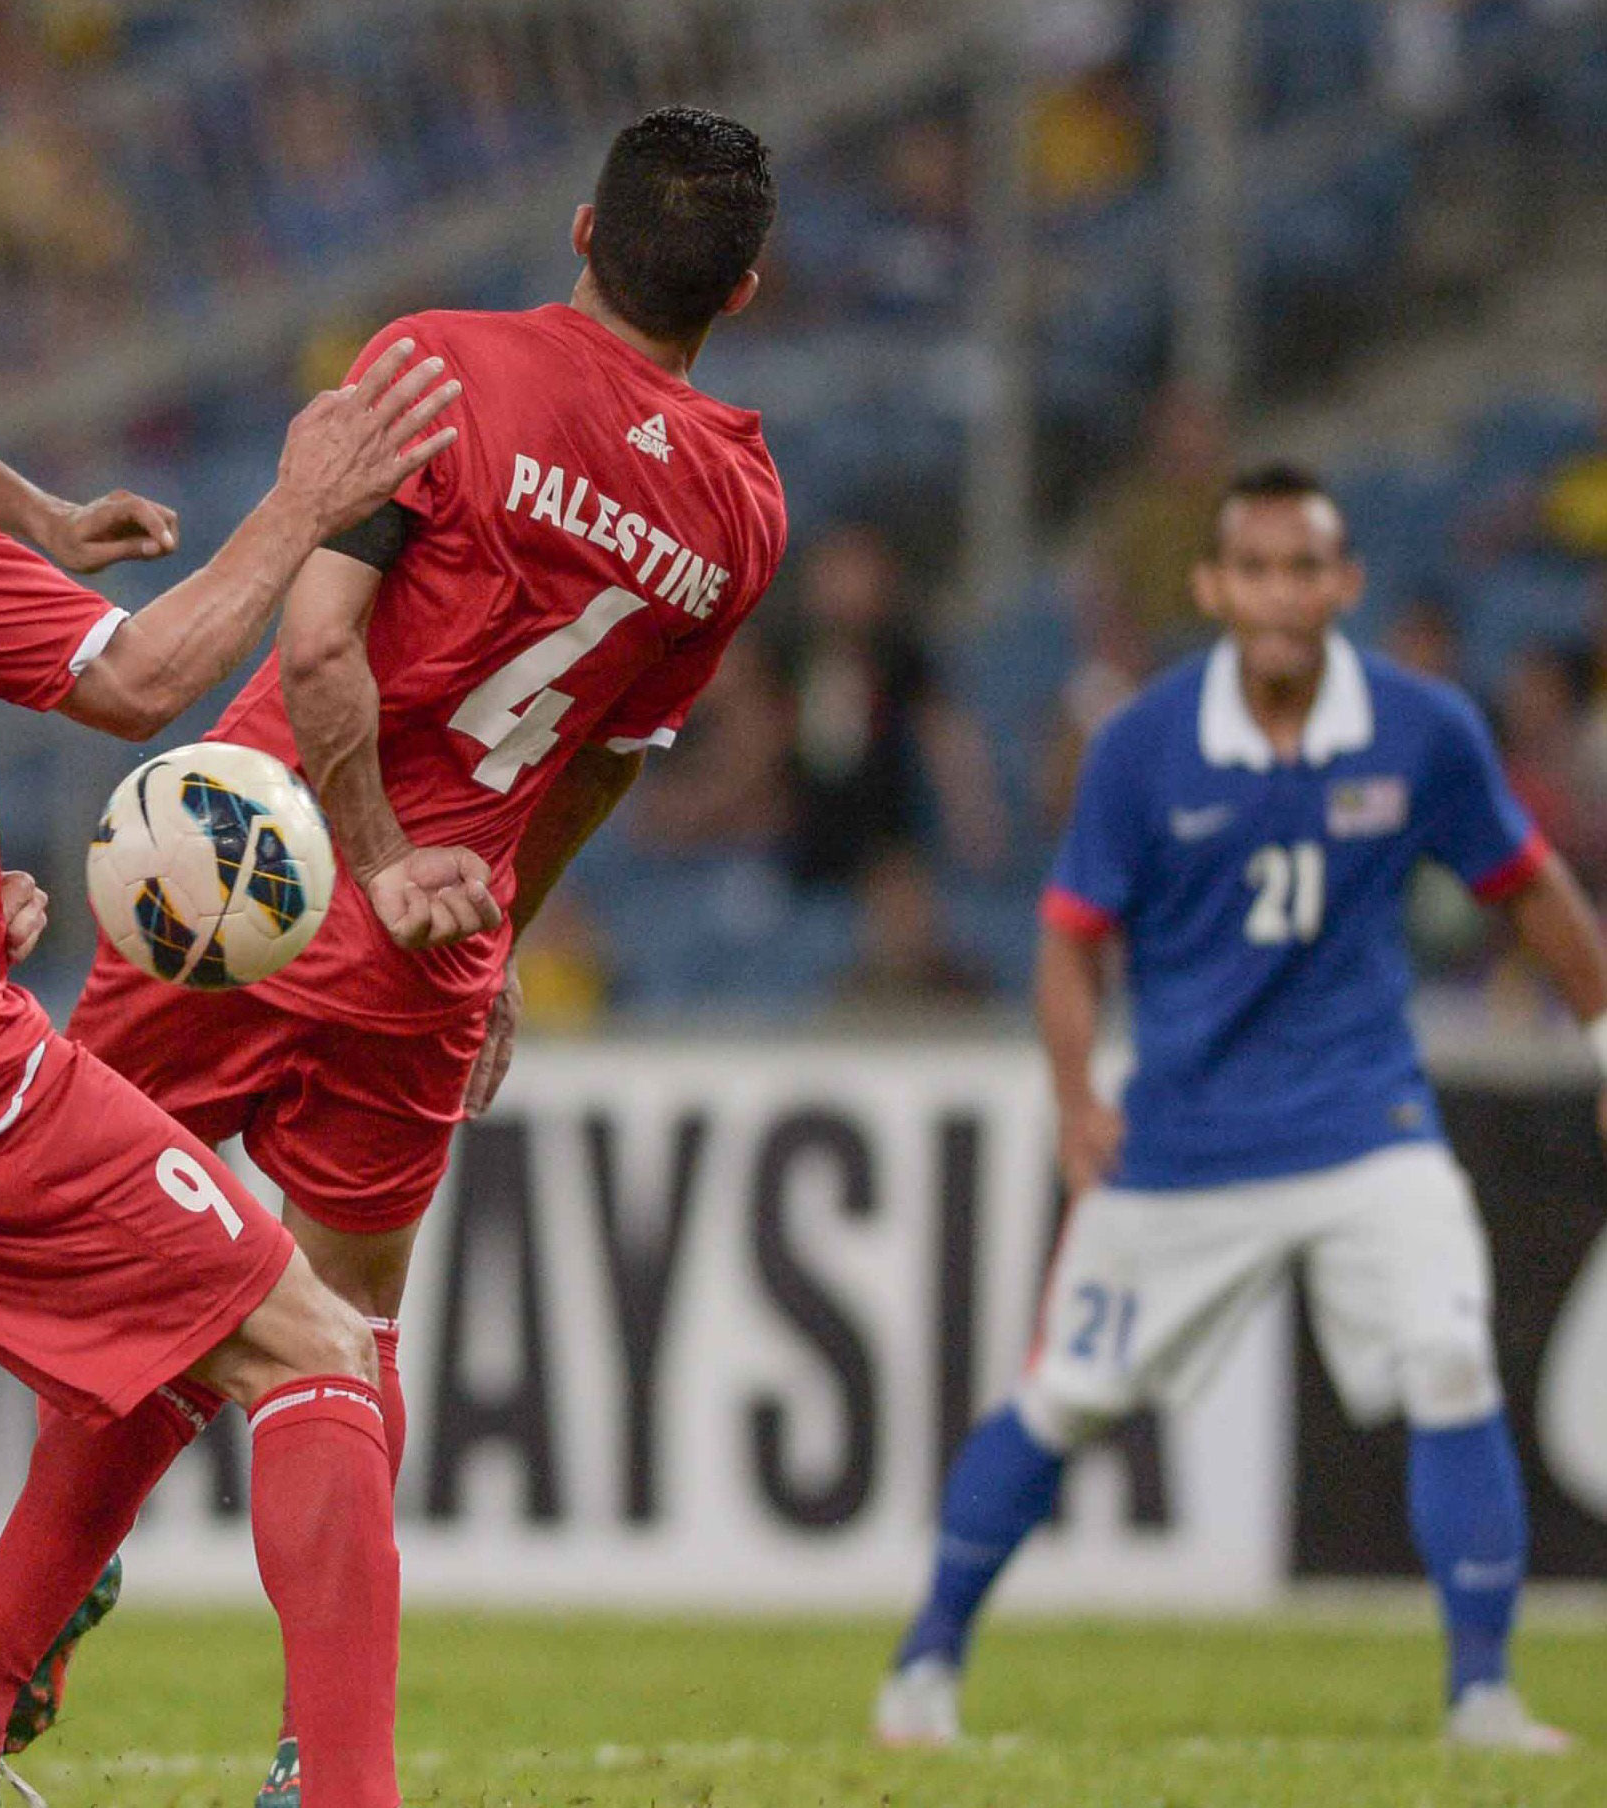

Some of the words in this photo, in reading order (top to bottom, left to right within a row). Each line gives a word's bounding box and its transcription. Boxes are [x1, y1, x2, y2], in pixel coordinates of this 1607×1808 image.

[626, 426, 674, 464] PEAK
[505, 453, 731, 620] PALESTINE
[448, 585, 650, 794] 4
[1244, 843, 1326, 945] 21
[156, 1147, 244, 1241] 9
[1067, 1282, 1139, 1366] 21
